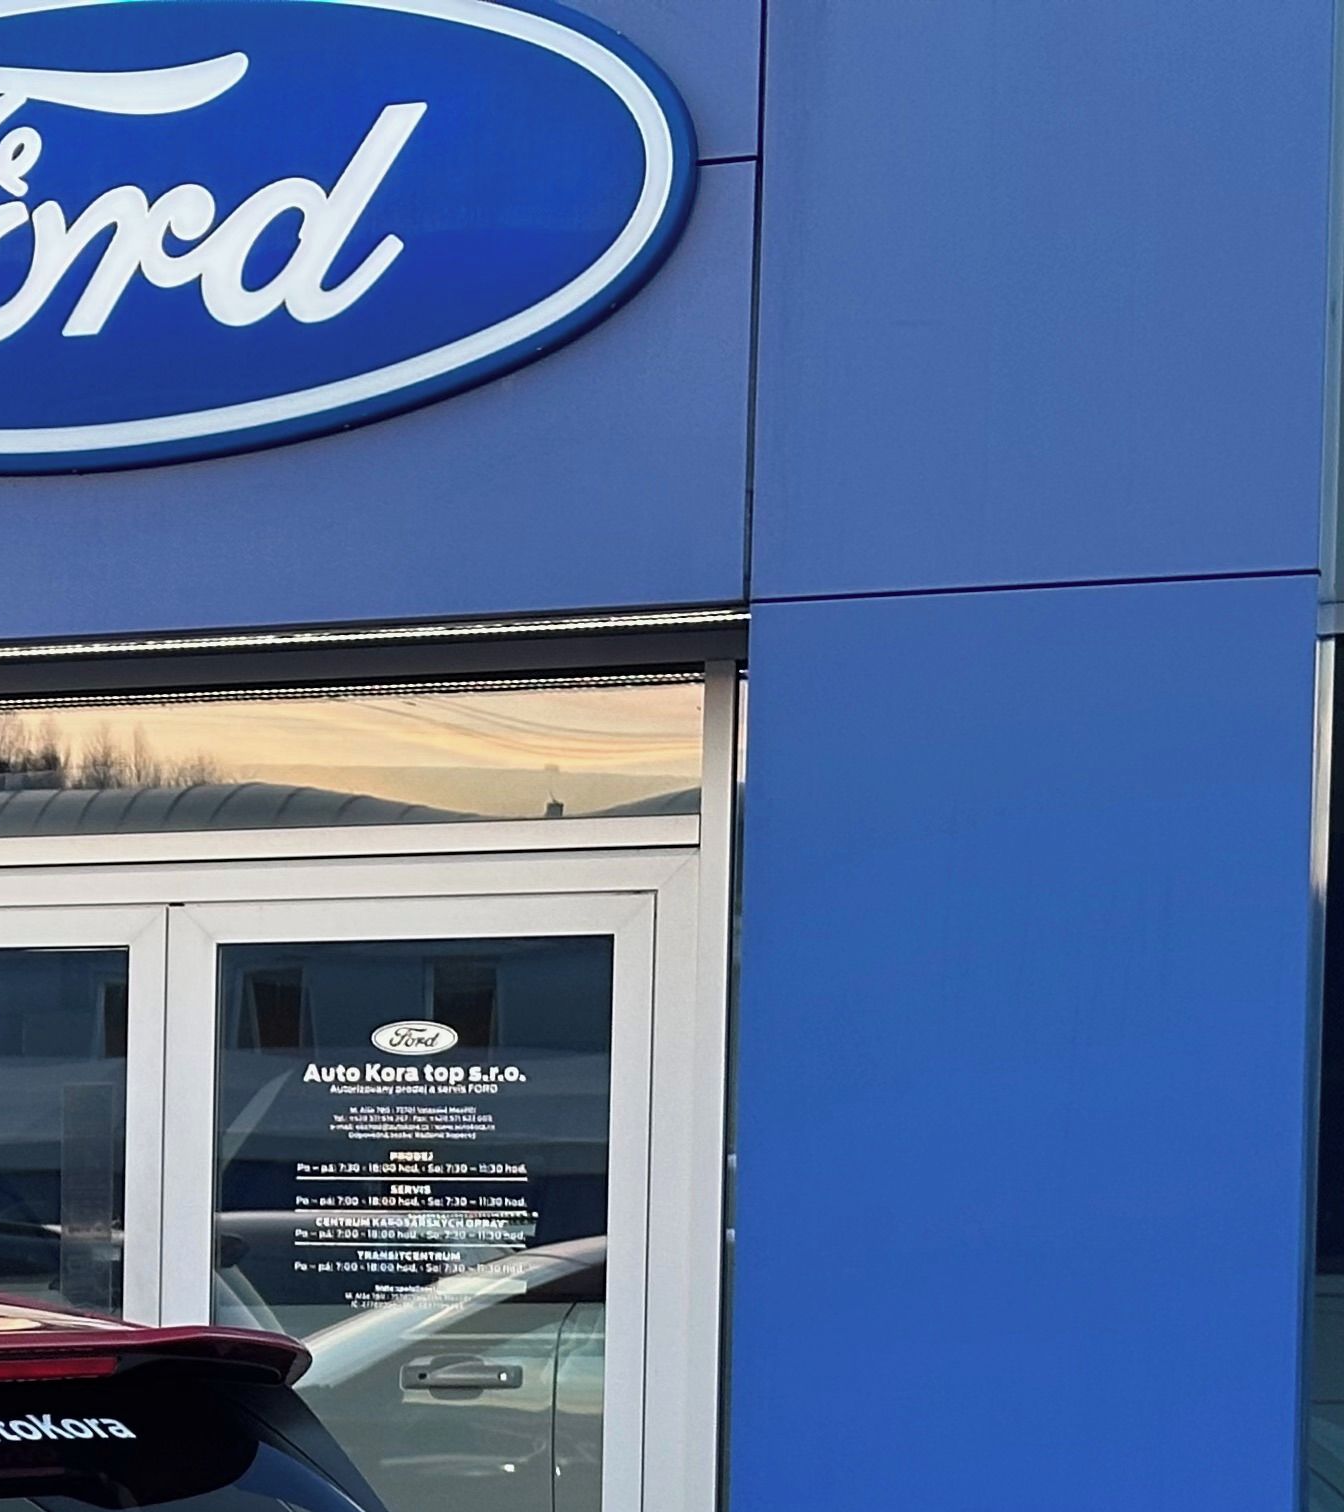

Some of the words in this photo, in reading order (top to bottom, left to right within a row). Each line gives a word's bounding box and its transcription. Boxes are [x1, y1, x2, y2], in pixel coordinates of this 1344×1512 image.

[389, 1027, 440, 1047] Ford
[303, 1063, 361, 1082] Auto
[365, 1063, 419, 1082] Kora
[424, 1064, 464, 1085] top
[468, 1065, 527, 1083] s.r.o.
[468, 1084, 498, 1094] FORD
[390, 1185, 431, 1194] SERVIS
[315, 1217, 370, 1227] CENTRUM
[357, 1251, 460, 1260] TRANSITCENTRUM
